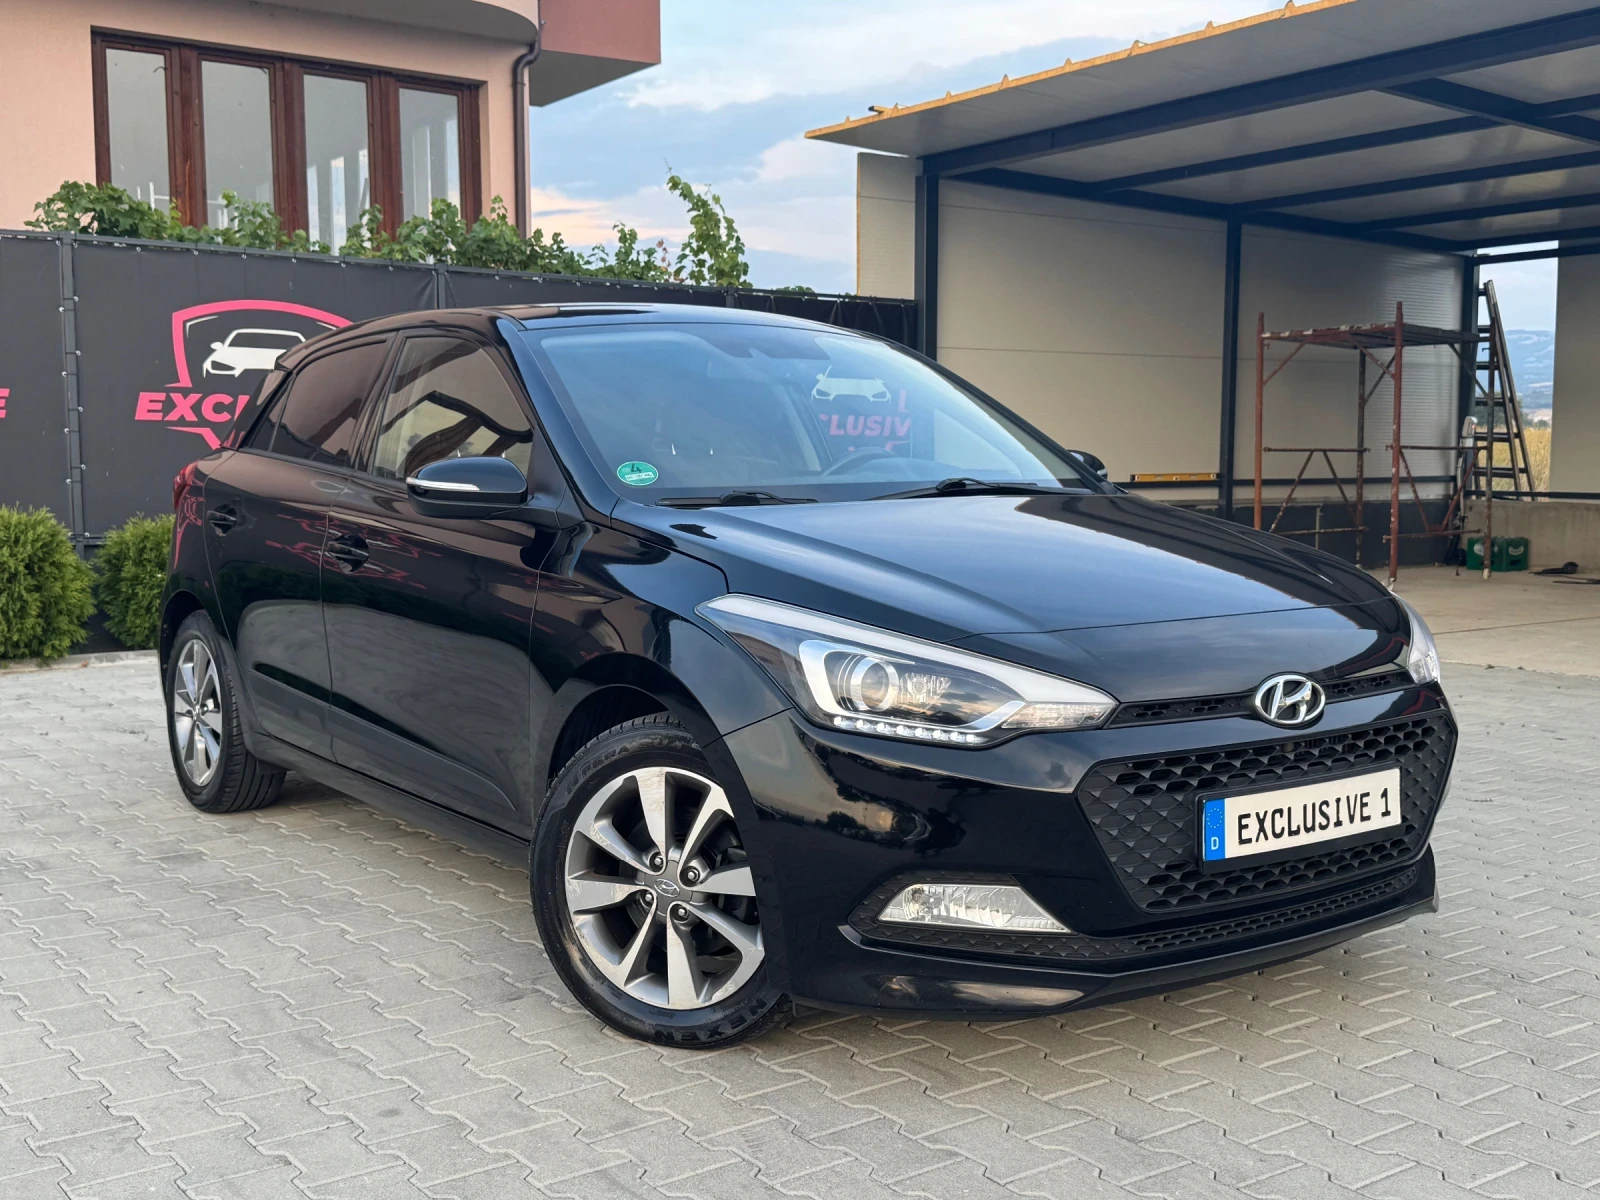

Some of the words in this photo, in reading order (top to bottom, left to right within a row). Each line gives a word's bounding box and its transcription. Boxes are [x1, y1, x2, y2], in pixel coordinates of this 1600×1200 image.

[1237, 791, 1371, 845] EXCLUSIVE
[1380, 787, 1391, 817] 1
[1210, 836, 1219, 850] D
